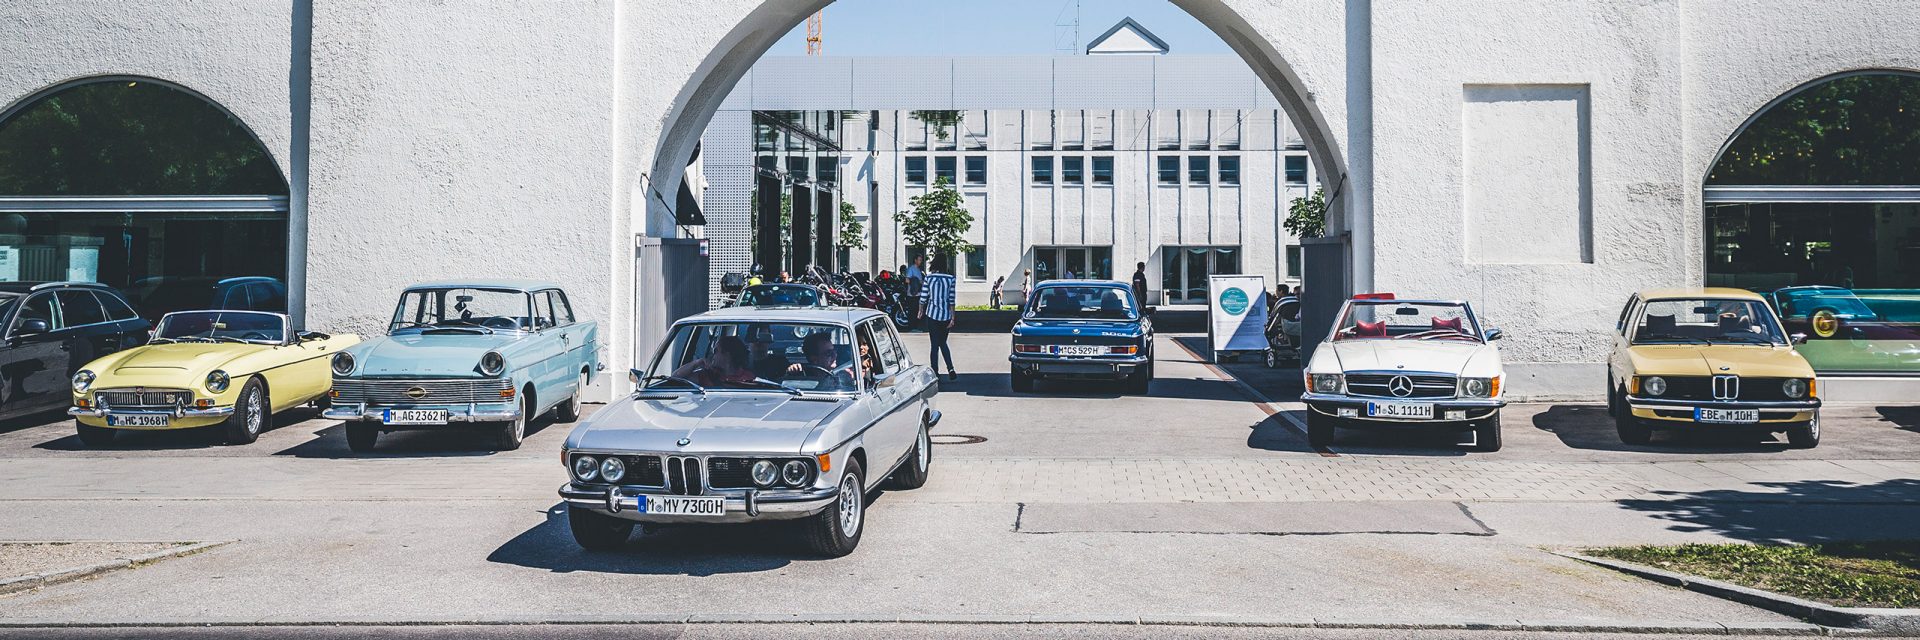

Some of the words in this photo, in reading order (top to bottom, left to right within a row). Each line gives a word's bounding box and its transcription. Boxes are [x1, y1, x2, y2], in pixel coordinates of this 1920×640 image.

[1067, 346, 1077, 354] CS
[1387, 405, 1399, 415] SL
[402, 411, 414, 421] AG
[1701, 410, 1720, 420] EBE
[1726, 411, 1733, 421] M
[125, 416, 137, 426] HC
[646, 498, 654, 512] M
[663, 499, 679, 513] MY
